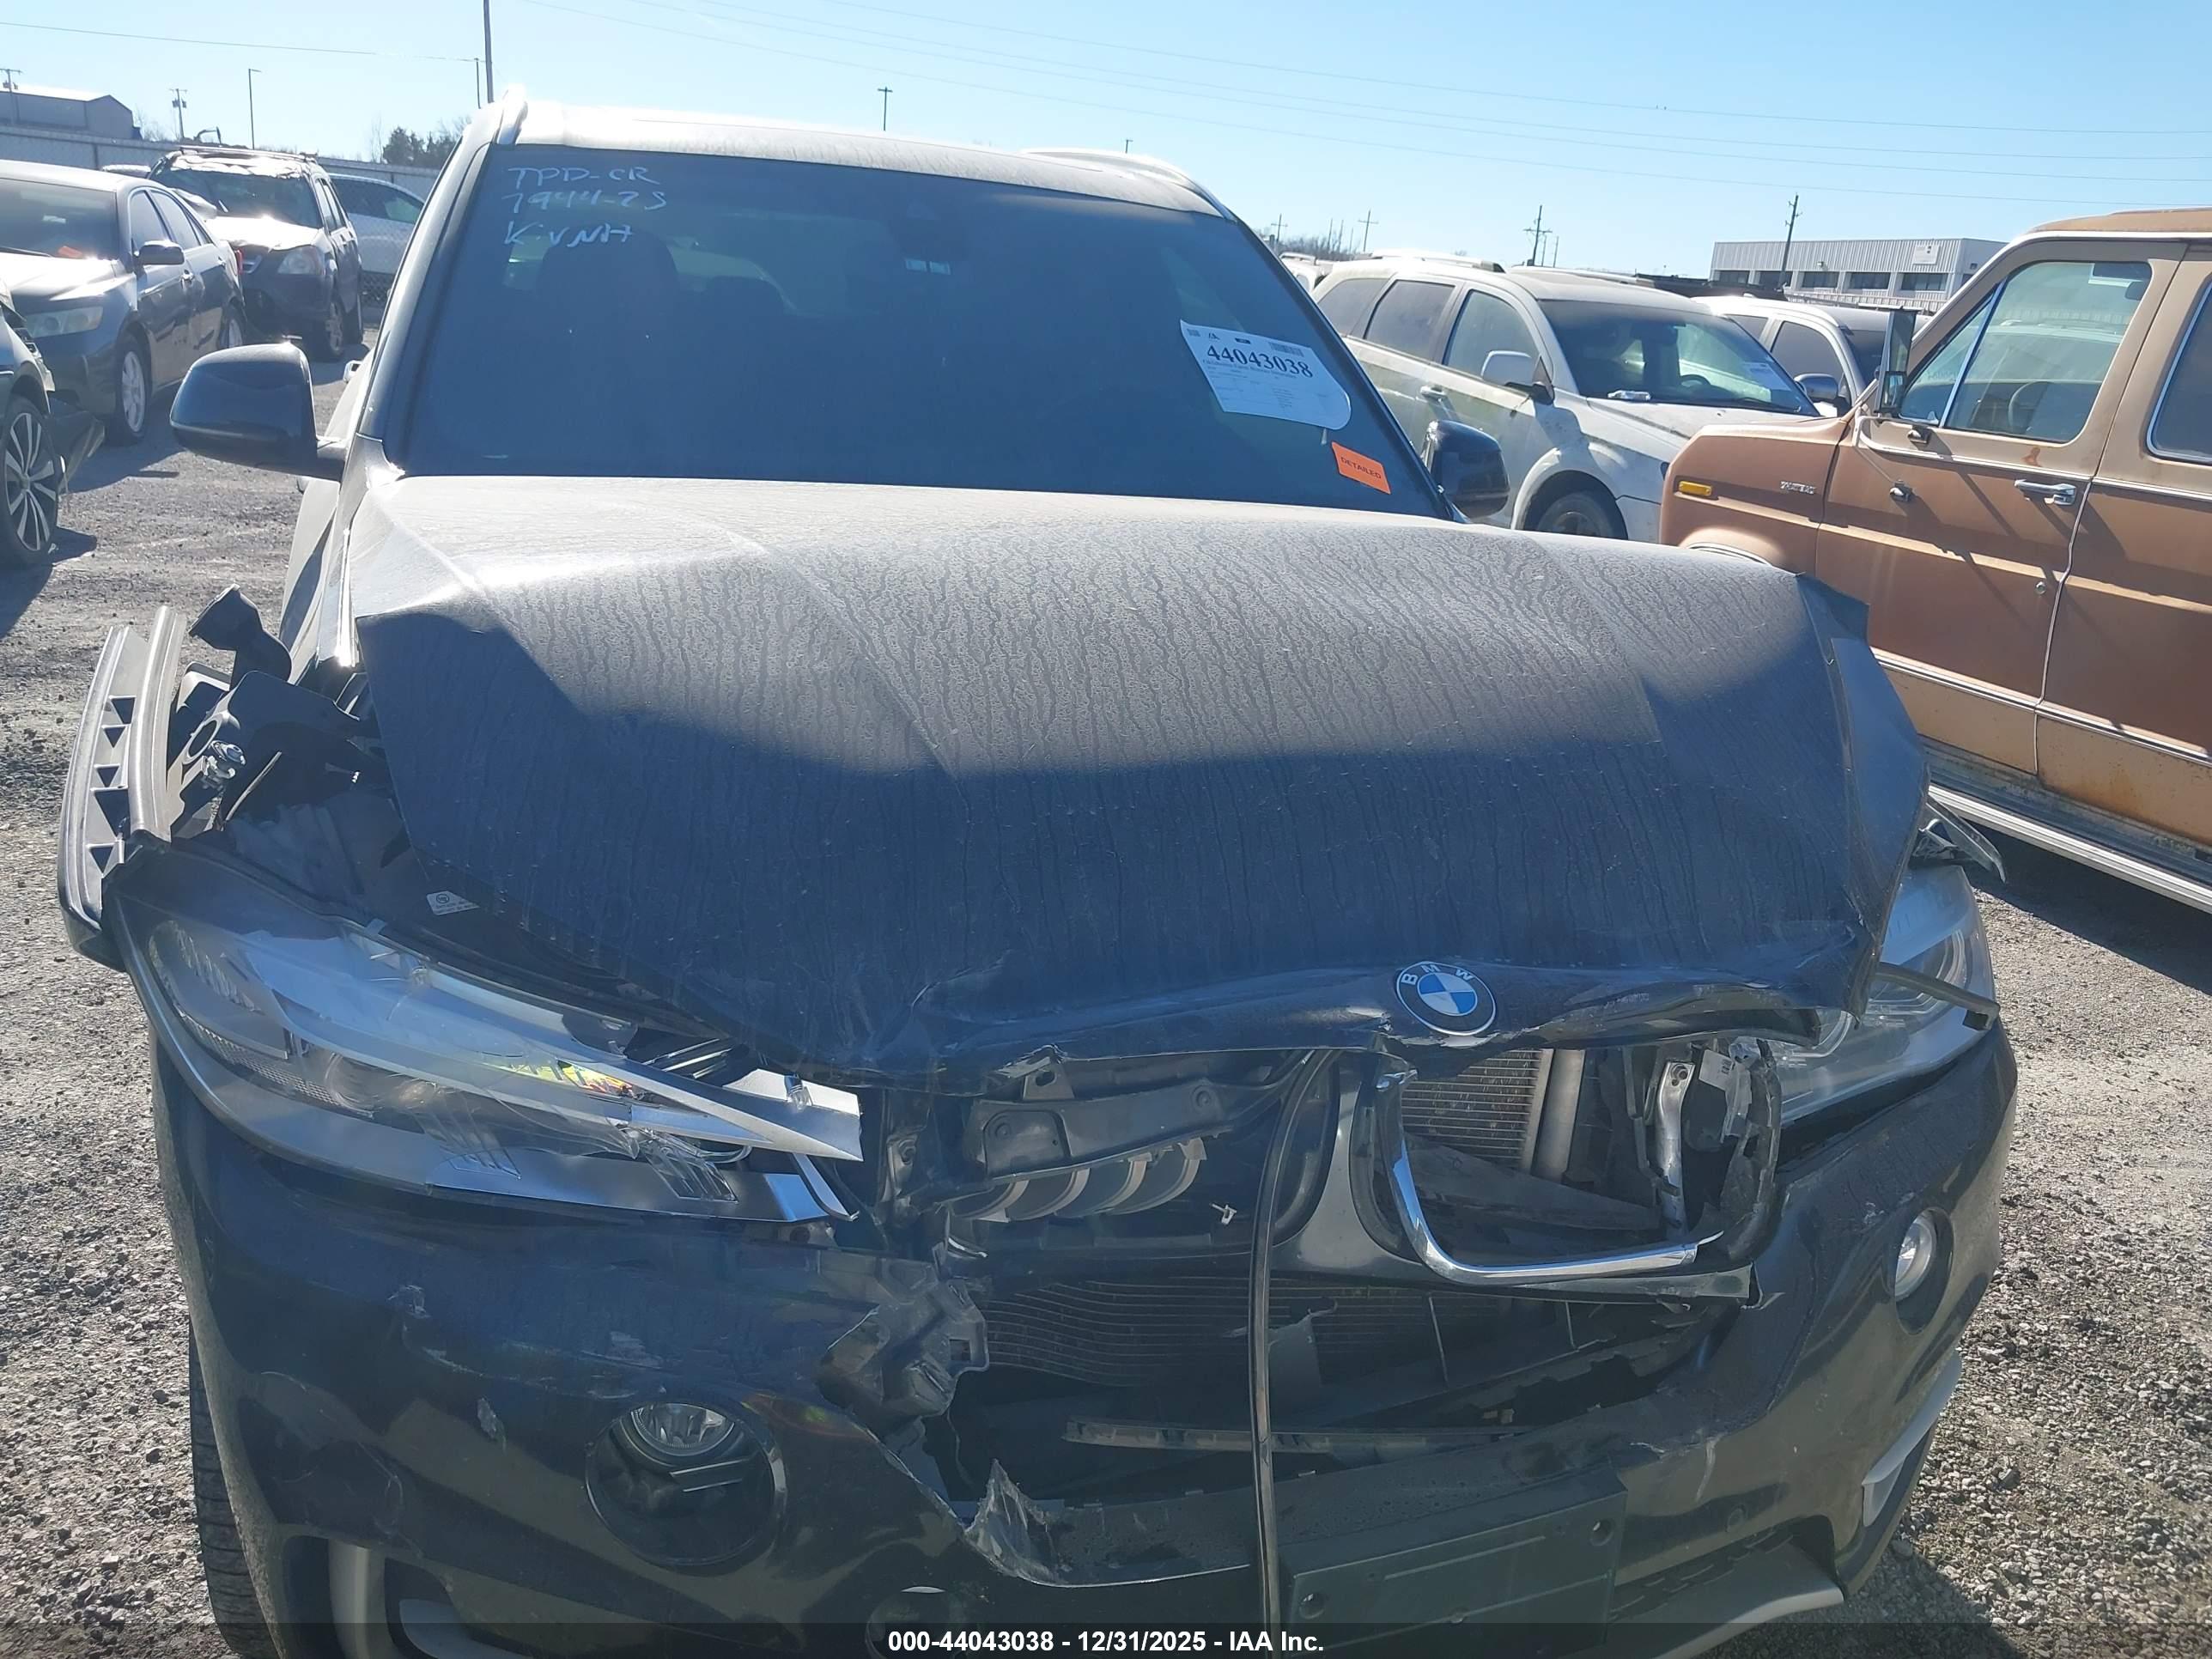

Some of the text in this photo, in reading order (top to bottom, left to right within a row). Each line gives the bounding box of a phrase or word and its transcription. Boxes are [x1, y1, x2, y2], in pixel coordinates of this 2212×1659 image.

[1206, 344, 1314, 378] 44043038
[1340, 456, 1382, 479] DETAILED
[1401, 964, 1474, 986] BMW
